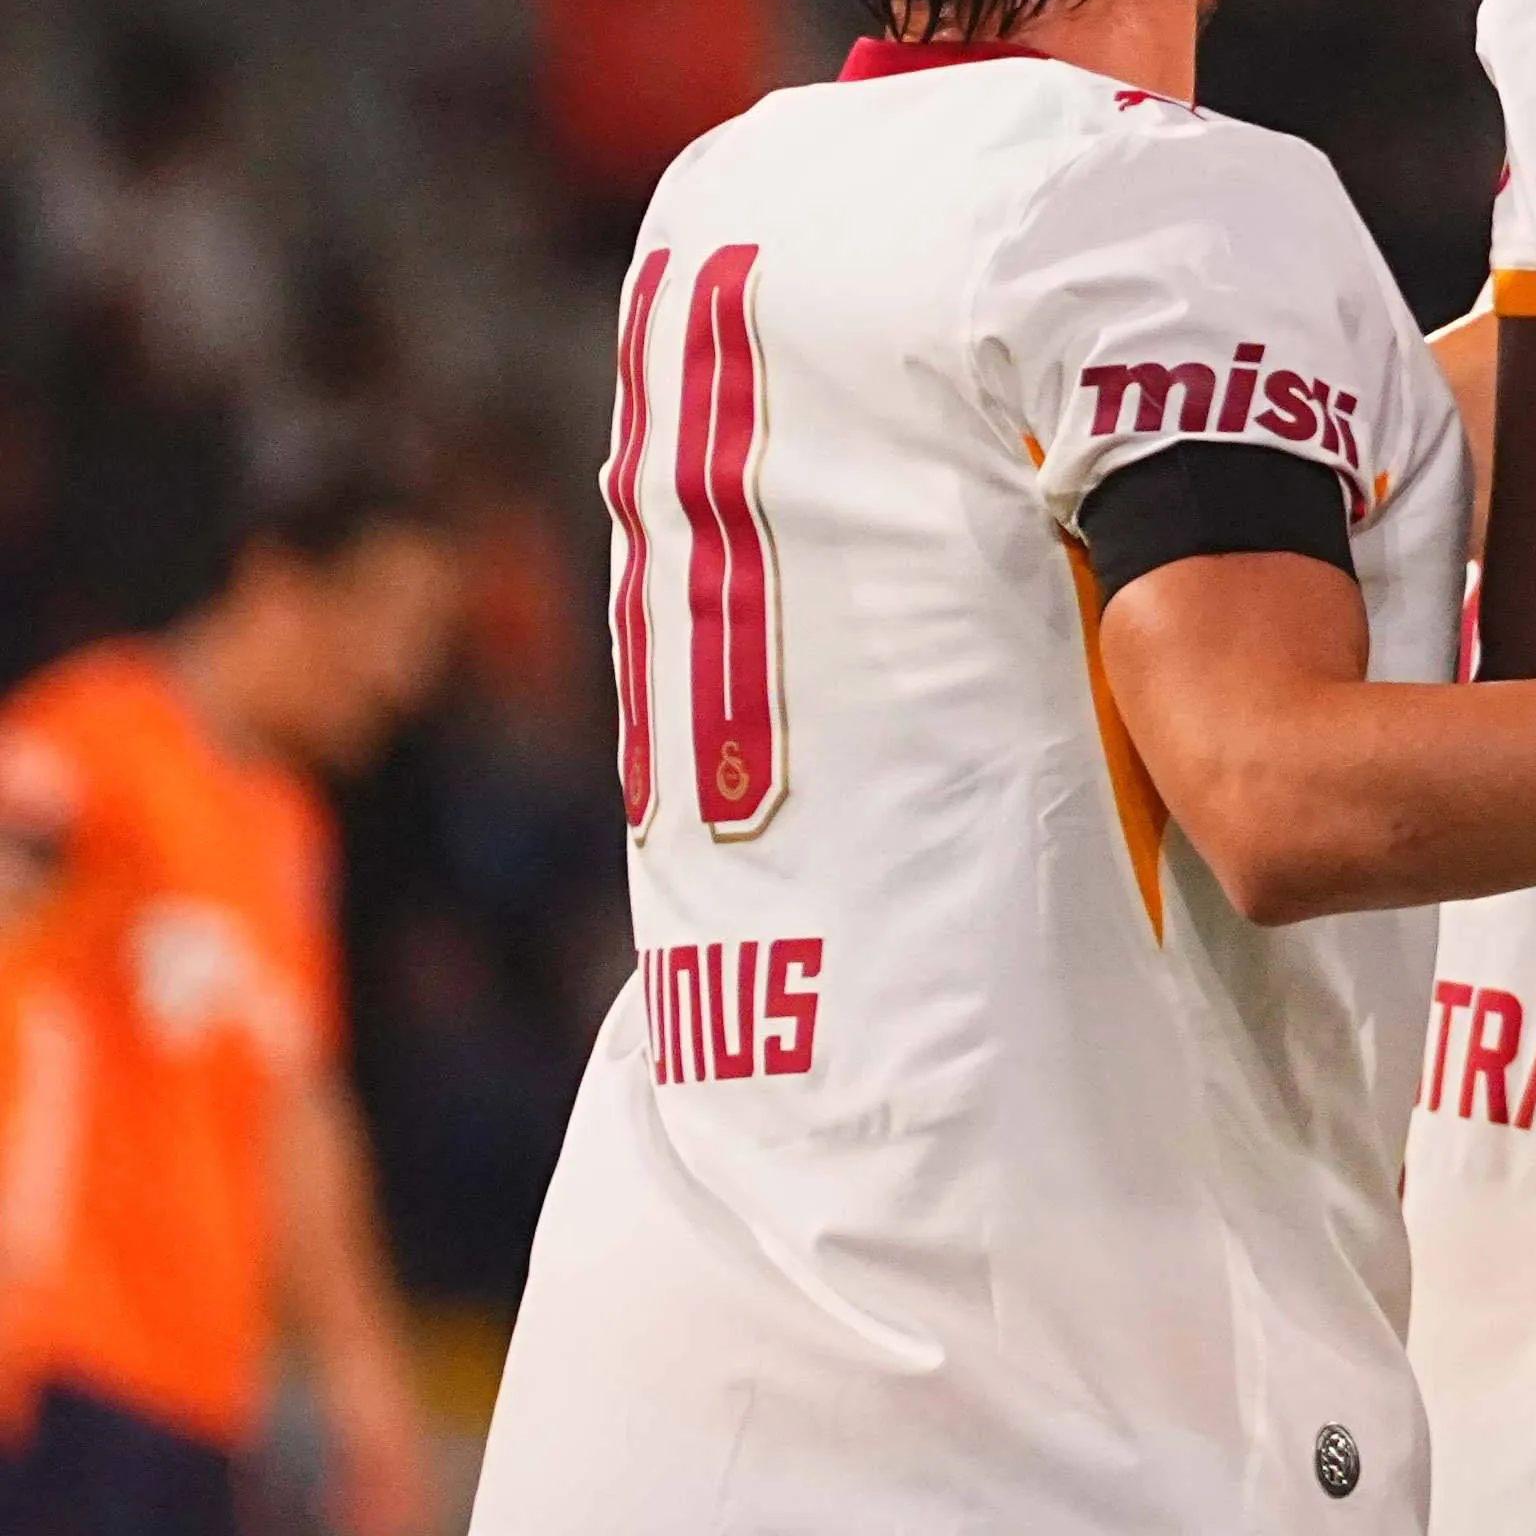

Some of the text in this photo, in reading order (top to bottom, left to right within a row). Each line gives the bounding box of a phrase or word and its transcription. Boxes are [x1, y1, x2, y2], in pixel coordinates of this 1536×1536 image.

[1080, 342, 1359, 470] misli
[607, 244, 789, 848] 11
[634, 937, 824, 1085] UNUS
